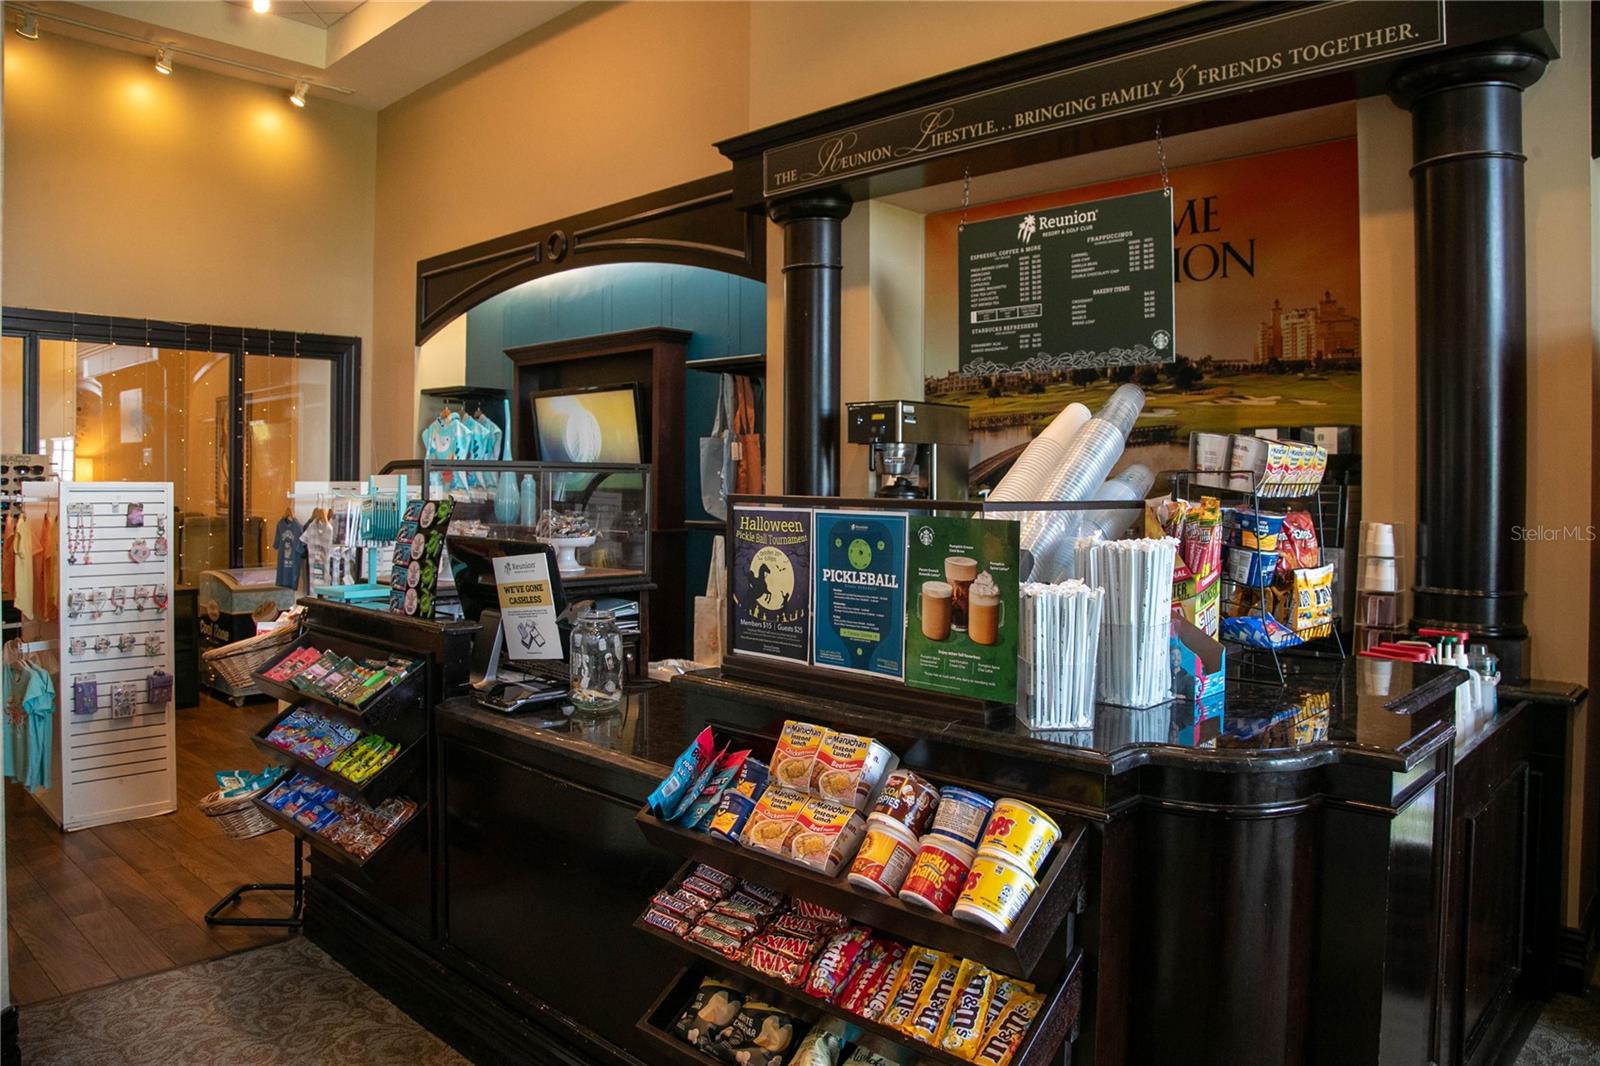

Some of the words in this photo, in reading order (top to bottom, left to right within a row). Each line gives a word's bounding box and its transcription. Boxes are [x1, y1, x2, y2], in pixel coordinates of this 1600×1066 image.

[774, 170, 797, 186] THE
[1015, 96, 1096, 127] BRINGING
[1101, 80, 1163, 107] FAMILY
[1168, 64, 1198, 96] &
[1198, 53, 1283, 86] FRIENDS
[1288, 22, 1419, 65] TOGETHER.
[1039, 210, 1097, 230] Reunion
[1080, 224, 1094, 232] CLUB
[998, 247, 1019, 256] COFFEE
[1093, 288, 1113, 296] BAKERY
[1114, 285, 1131, 293] ITEMS
[740, 516, 804, 533] Halloween
[736, 530, 755, 542] Pickle
[756, 533, 768, 544] Ball
[768, 534, 809, 545] Tournament
[822, 569, 898, 588] PICKLEBALL
[504, 585, 525, 594] WE'VE
[525, 584, 544, 592] GONE
[509, 595, 542, 605] CASHLESS
[740, 618, 763, 628] Members
[763, 622, 773, 630] $15
[777, 623, 794, 632] Guests
[794, 625, 803, 634] $25
[791, 724, 822, 737] Maruchan
[790, 734, 811, 743] Instant
[790, 740, 807, 748] Lunch
[833, 735, 867, 749] Maruchan
[832, 744, 857, 754] Instant
[832, 750, 852, 760] Lunch
[771, 796, 793, 806] Instant
[774, 789, 805, 802] Maruchan
[770, 802, 788, 811] Lunch
[816, 801, 849, 816] Maruchan
[813, 814, 832, 824] Lunch
[814, 809, 838, 820] Instant
[765, 934, 809, 958] TWIX
[752, 946, 796, 975] TWIX
